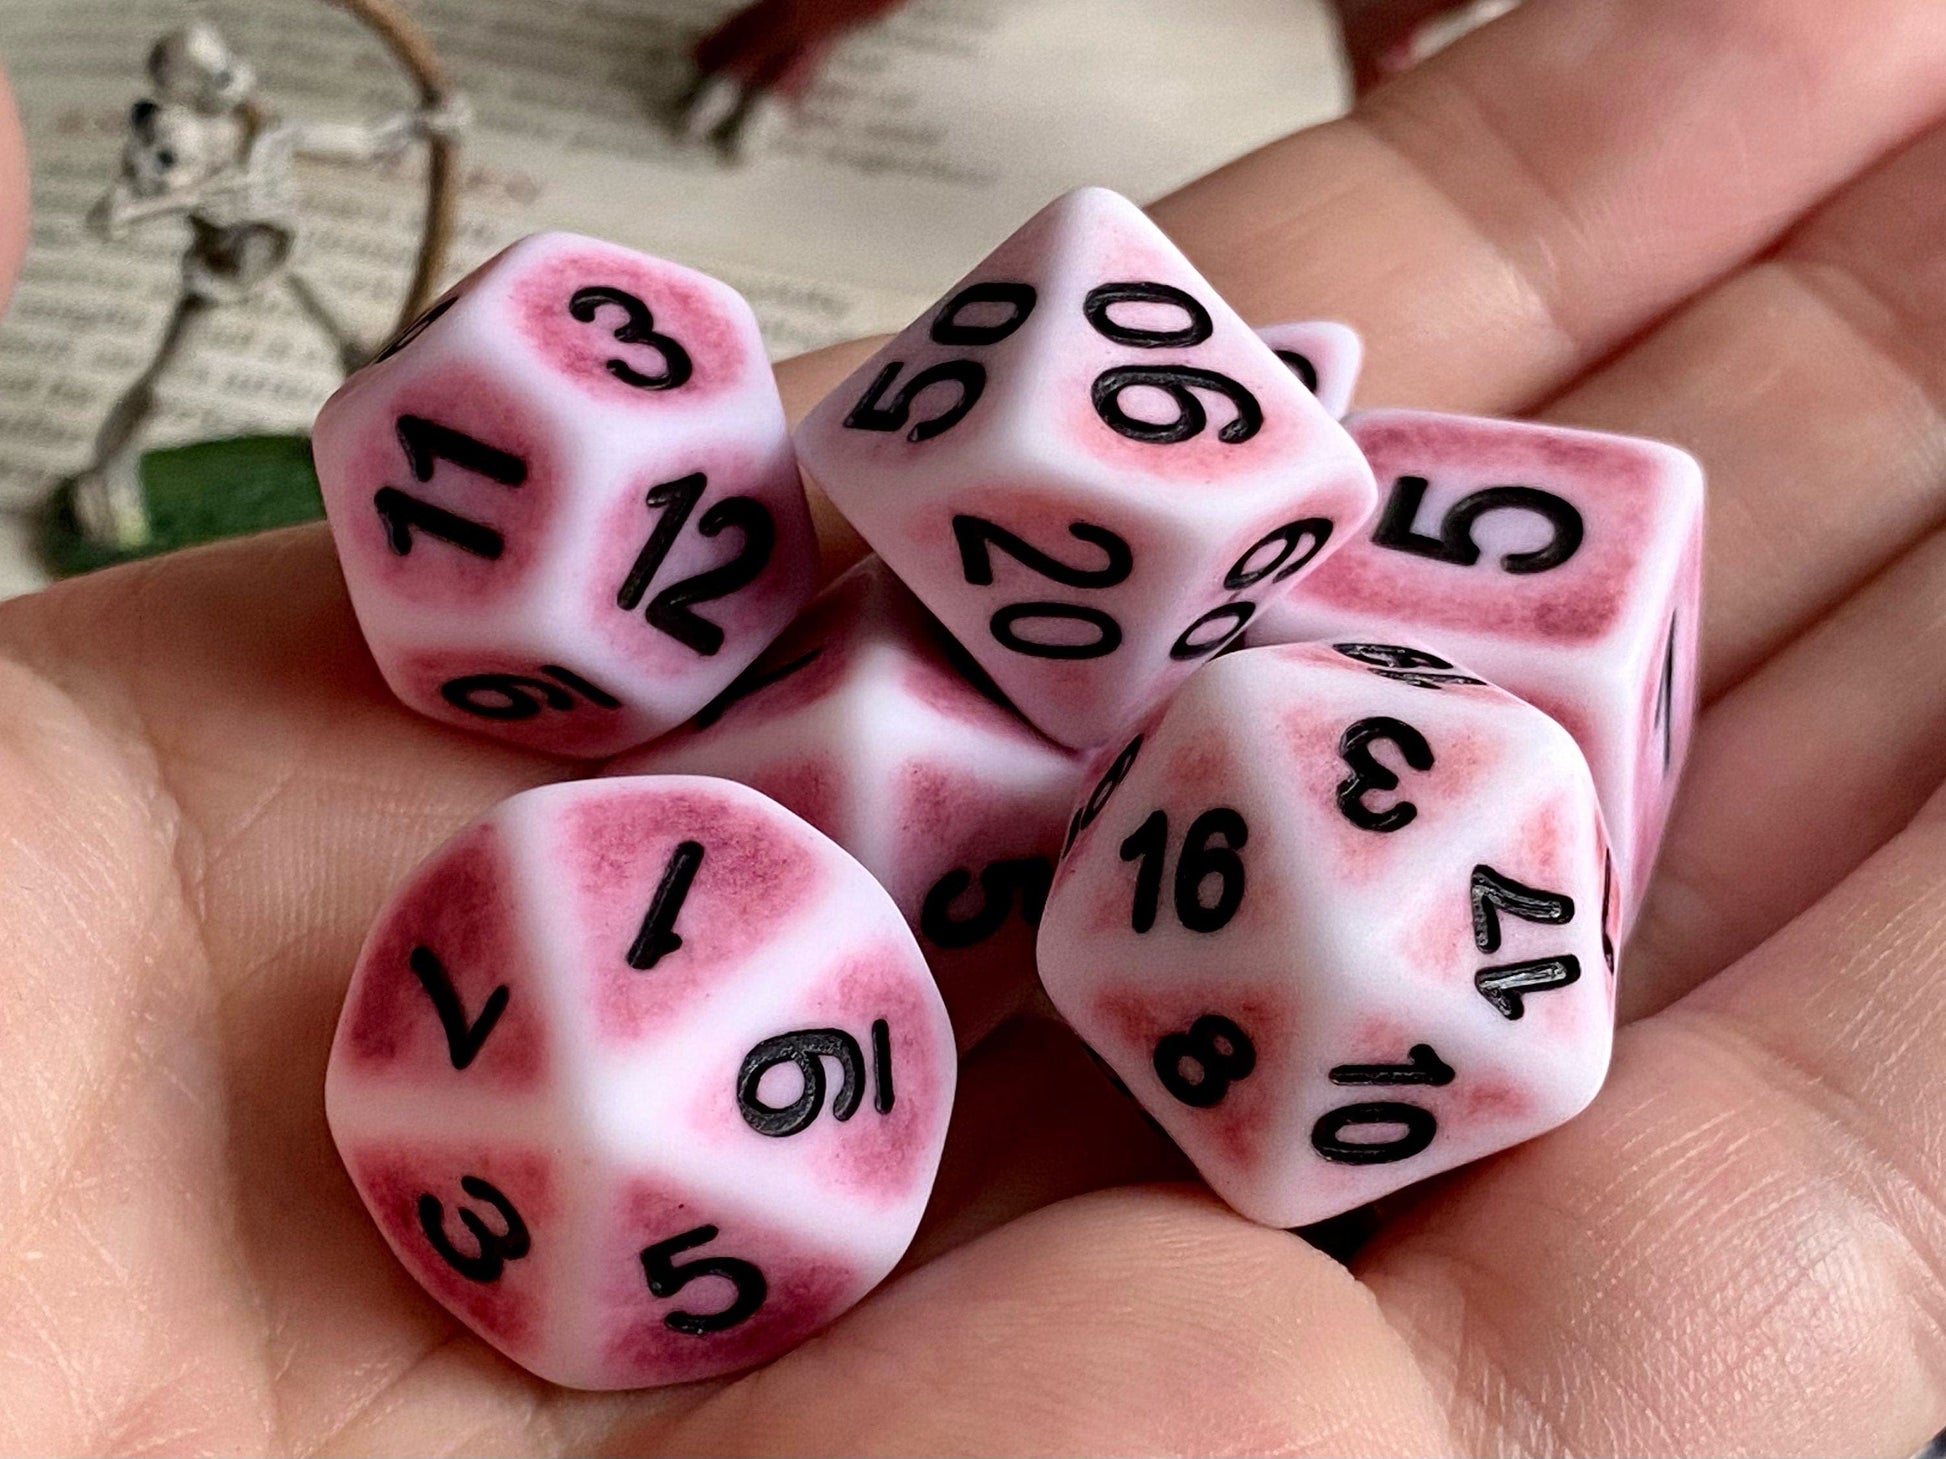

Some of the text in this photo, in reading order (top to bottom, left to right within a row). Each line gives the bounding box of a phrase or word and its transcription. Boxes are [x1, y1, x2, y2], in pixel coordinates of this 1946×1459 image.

[568, 285, 694, 392] 3
[841, 280, 1039, 445] 50
[1083, 280, 1264, 445] 90
[372, 412, 529, 562] 11
[1371, 474, 1585, 575] 5
[615, 471, 776, 657] 12
[943, 510, 1135, 662] 20
[1336, 715, 1436, 834] 3
[626, 839, 706, 971] 1
[920, 857, 1055, 949] 5
[1118, 806, 1250, 936] 16
[1469, 863, 1582, 1022] 17
[409, 944, 511, 1072] 7
[1152, 1013, 1257, 1109] 8
[1311, 1042, 1457, 1165] 10
[416, 1174, 532, 1284] 3
[639, 1223, 769, 1336] 5
